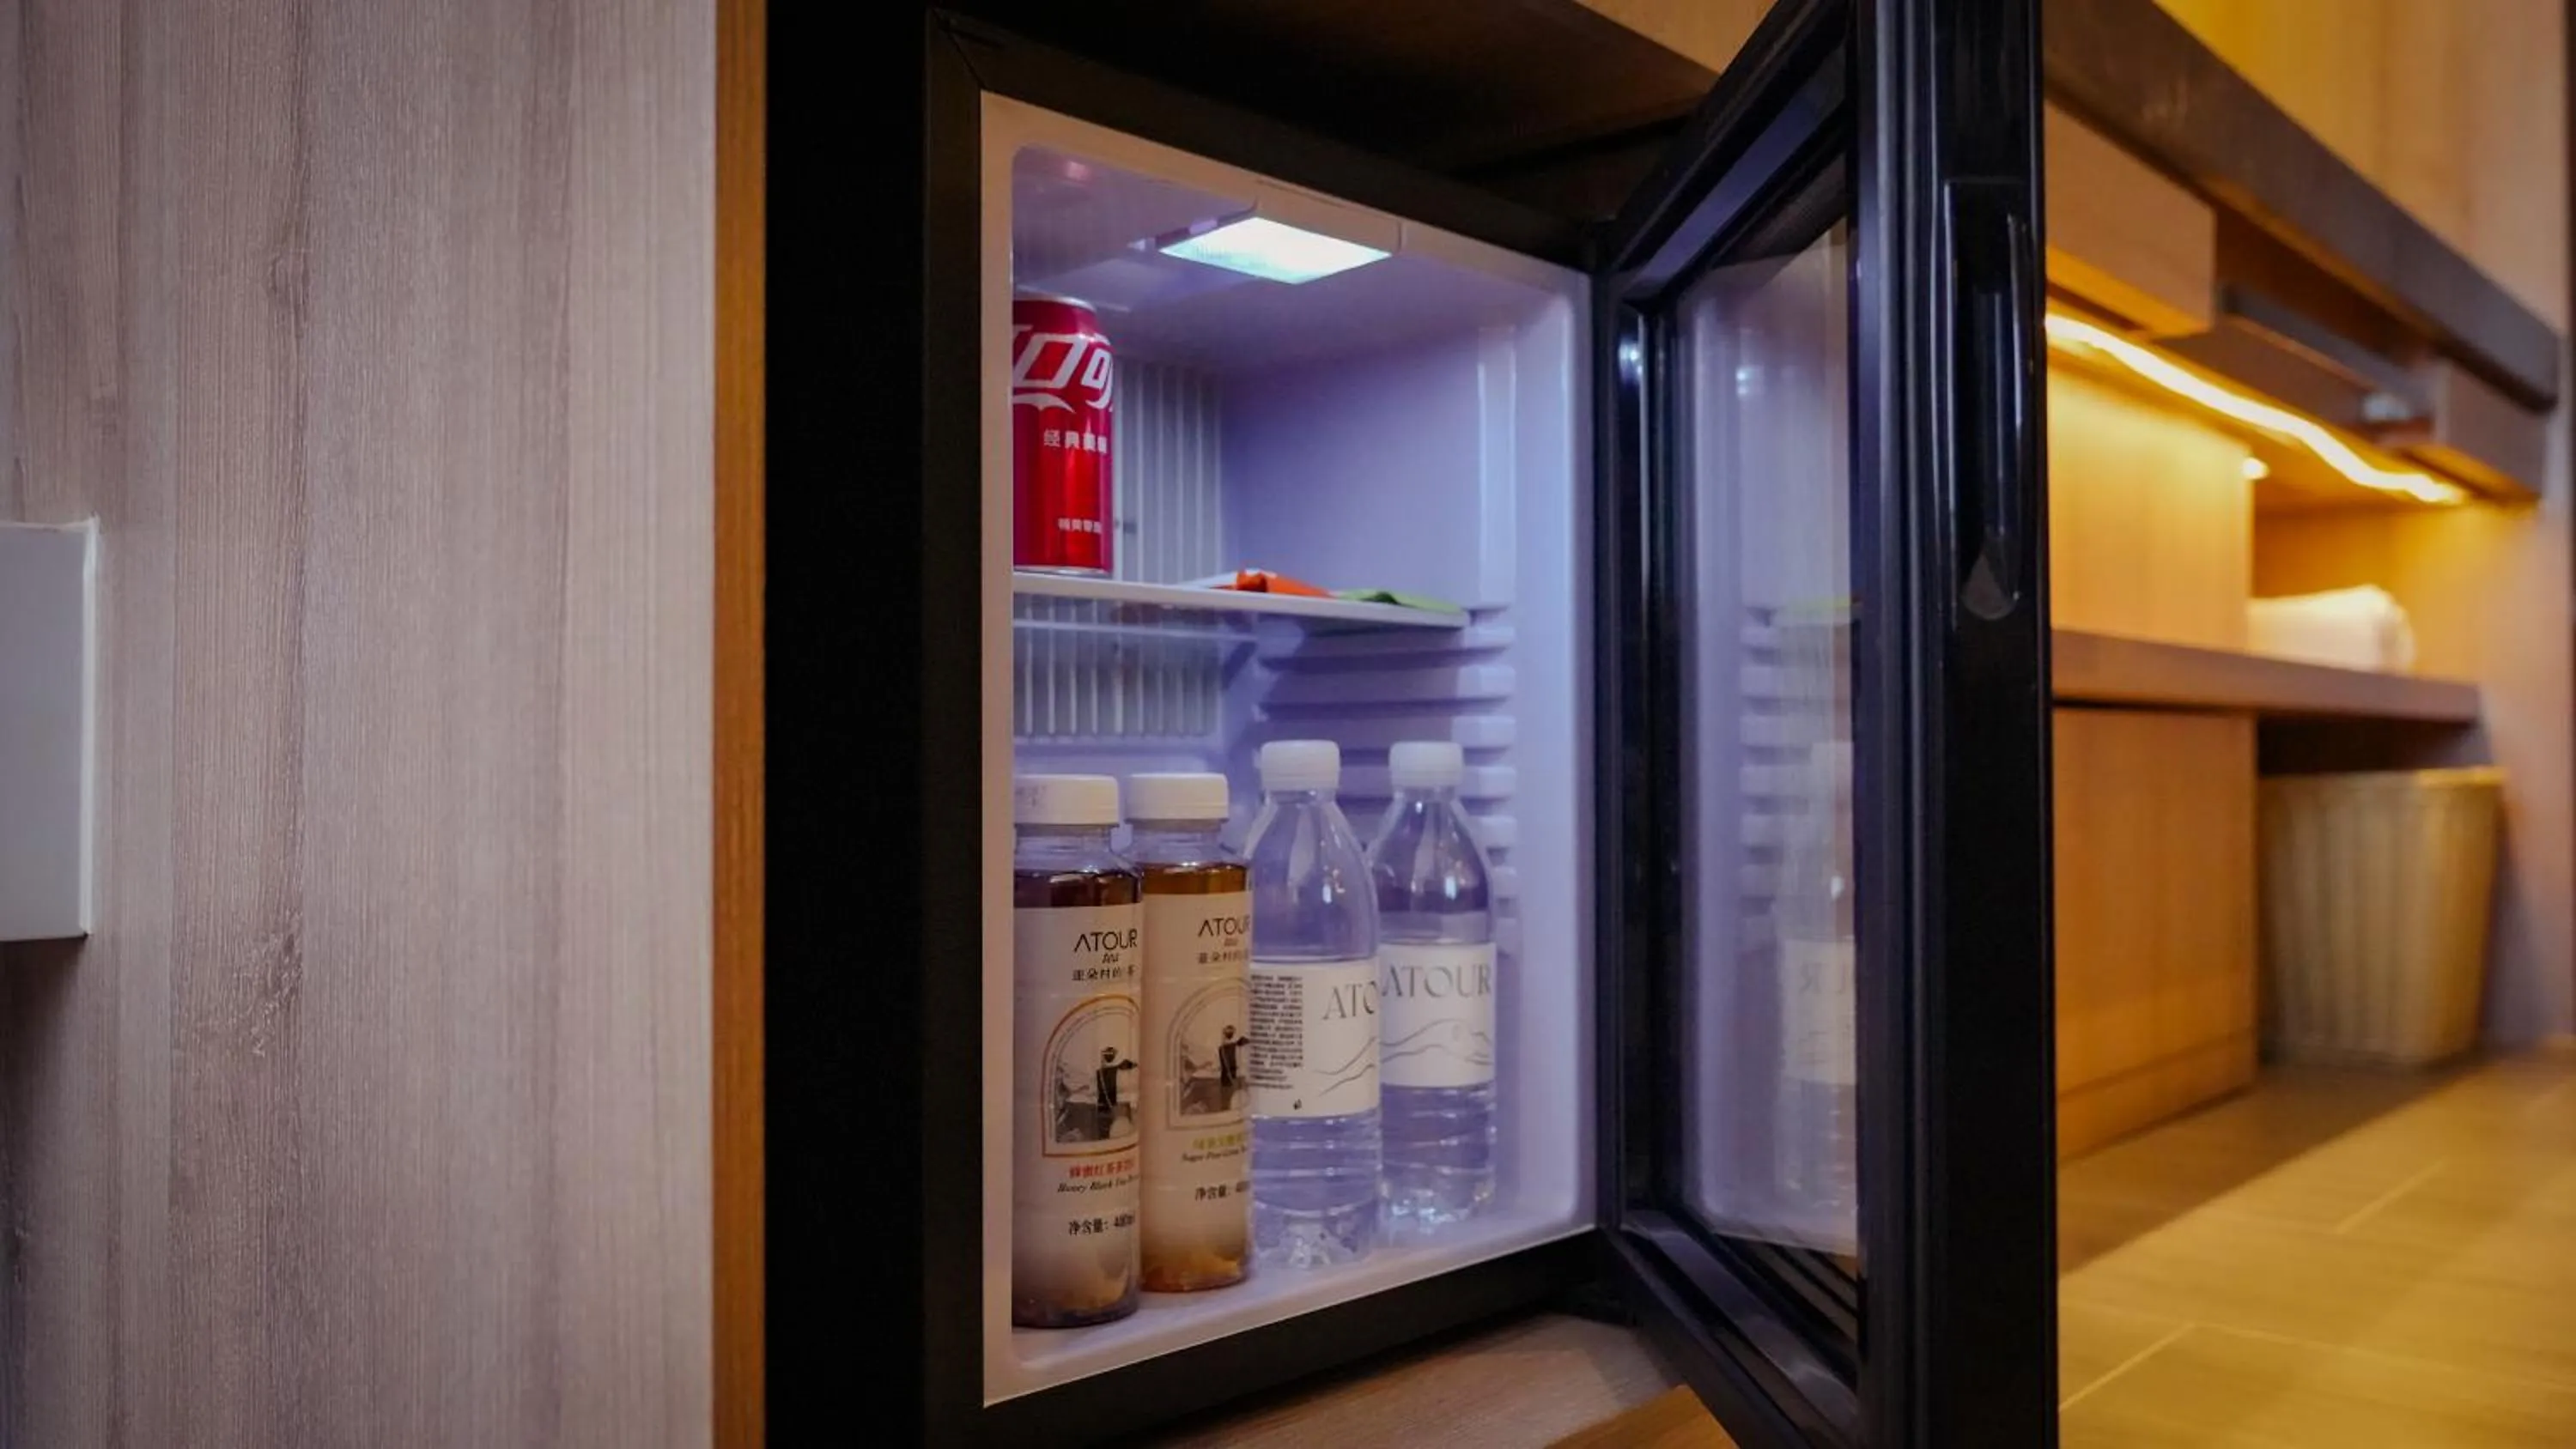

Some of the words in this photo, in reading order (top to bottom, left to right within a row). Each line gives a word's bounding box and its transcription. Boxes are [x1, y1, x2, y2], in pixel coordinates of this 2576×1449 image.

[1013, 324, 1114, 412] 口可
[1073, 928, 1138, 953] ATOUR
[1381, 963, 1492, 997] ATOUR
